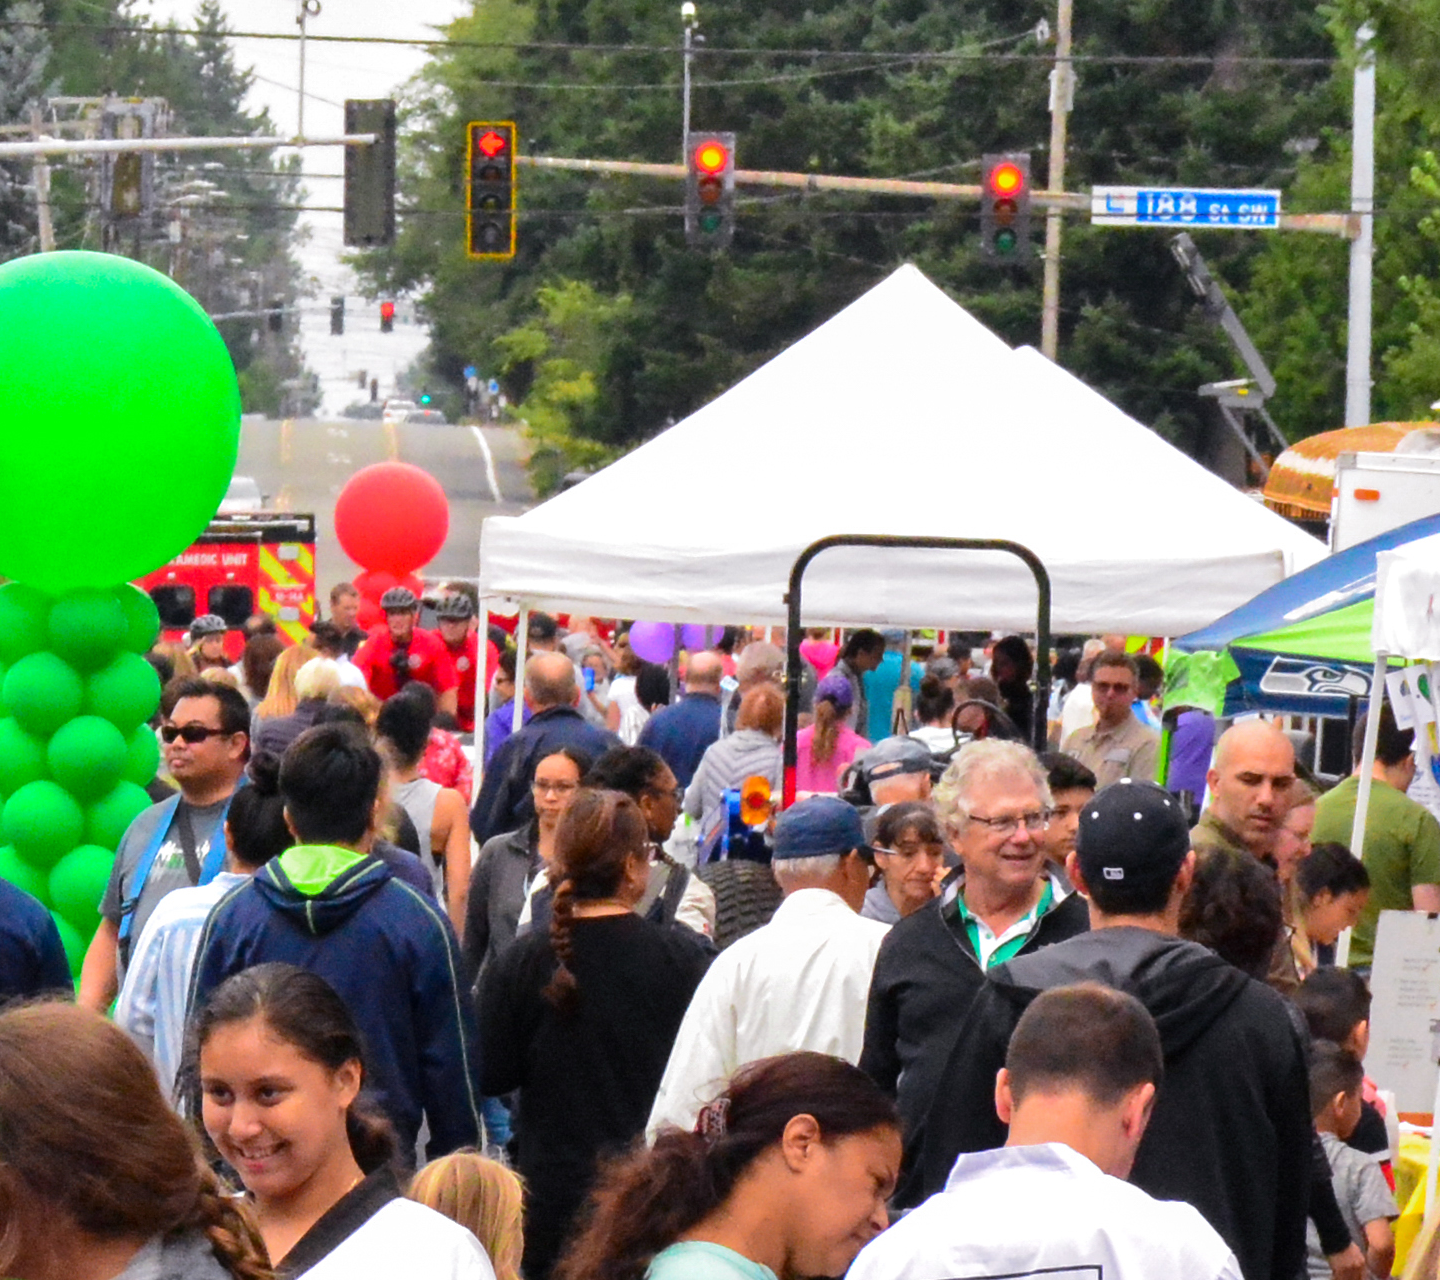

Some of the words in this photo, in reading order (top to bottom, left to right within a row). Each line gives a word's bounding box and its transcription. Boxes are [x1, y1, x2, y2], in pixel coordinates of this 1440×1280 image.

[1146, 193, 1198, 222] 188
[1238, 204, 1268, 223] SW
[221, 552, 248, 566] UNIT
